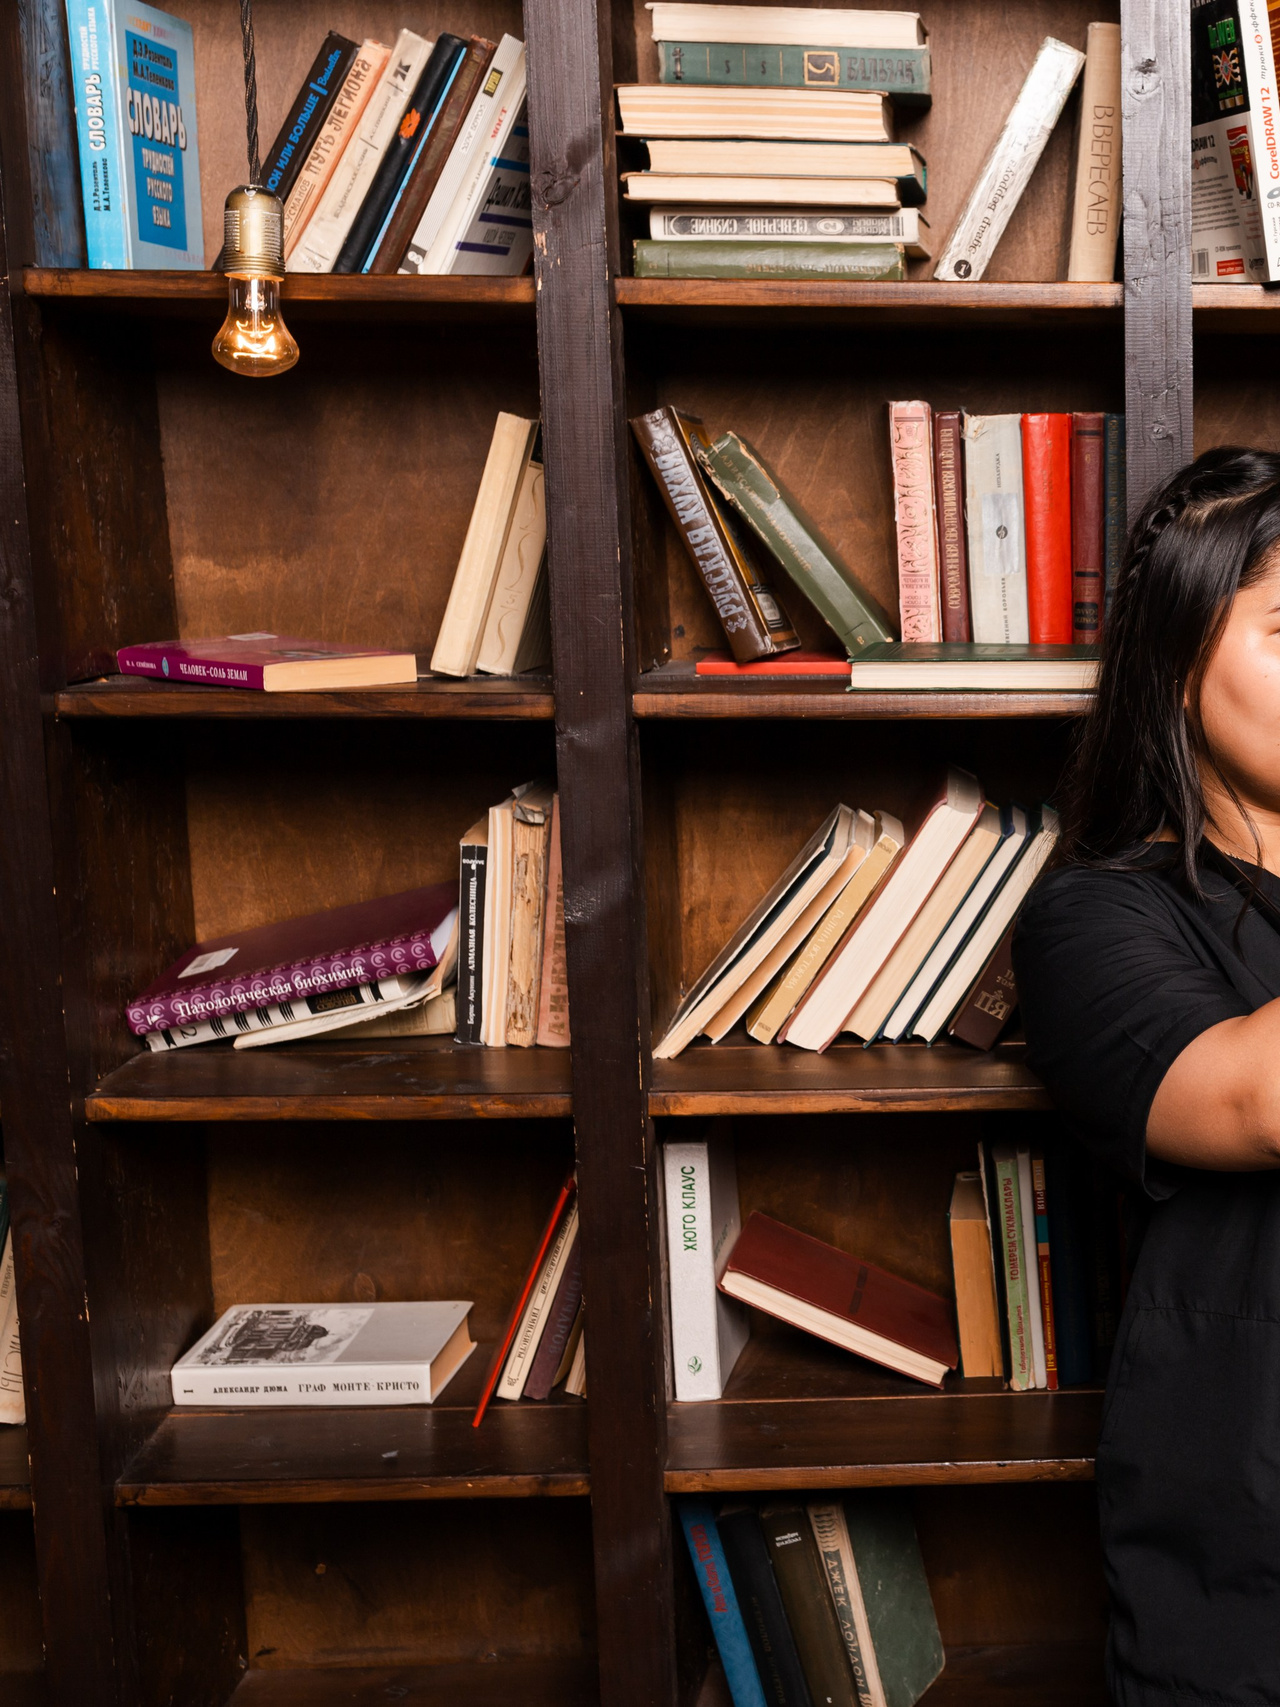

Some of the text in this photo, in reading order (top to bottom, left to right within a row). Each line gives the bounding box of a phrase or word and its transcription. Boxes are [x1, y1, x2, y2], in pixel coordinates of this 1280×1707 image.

[88, 7, 99, 70] РУССКОГО ЯЗЫКА
[846, 55, 917, 85] БАЛЬЗАК
[85, 73, 106, 151] СЛОВАРЬ
[127, 87, 187, 151] СЛОВАРЬ
[276, 142, 295, 170] ИЛИ
[289, 93, 319, 144] БОЛЬШЕ
[490, 106, 508, 140] МОСТ
[1260, 86, 1280, 180] CorelDRAW 12
[142, 147, 174, 177] ТРУДНОСТЕЙ
[289, 58, 372, 222] УСМАНОВ ПУТЬ ЛЕГИОНА
[147, 177, 173, 203] РУССКОГО
[1086, 104, 1115, 236] В.ВЕРЕСАЕВ
[153, 205, 171, 229] ЯЗЫКА
[690, 216, 808, 235] СЕВЕРНОЕ СИЯНИЕ
[656, 452, 744, 620] РУССКАЯ КУХНЯ
[226, 667, 248, 682] ЗЕМЛИ
[469, 876, 477, 925] КОЛЕСНИЦА
[468, 929, 476, 970] АЛМАЗНАЯ
[782, 908, 845, 991] ГАЛИНА ВОСТОКОВА
[179, 980, 292, 1018] Патологическая
[294, 963, 365, 995] биохимия
[467, 1004, 475, 1024] Борис
[680, 1165, 698, 1252] ХЮГО КЛАУС
[1032, 1164, 1046, 1210] ИСТОРИЯ
[1007, 1240, 1019, 1280] ГОМЕРЕМ
[516, 1305, 540, 1360] ГИМНАЗИСТЫ
[213, 1385, 260, 1393] АЛЕКСАНДР
[298, 1383, 326, 1392] ГРАФ
[826, 1559, 866, 1688] ДЖЕК ЛОНДОН
